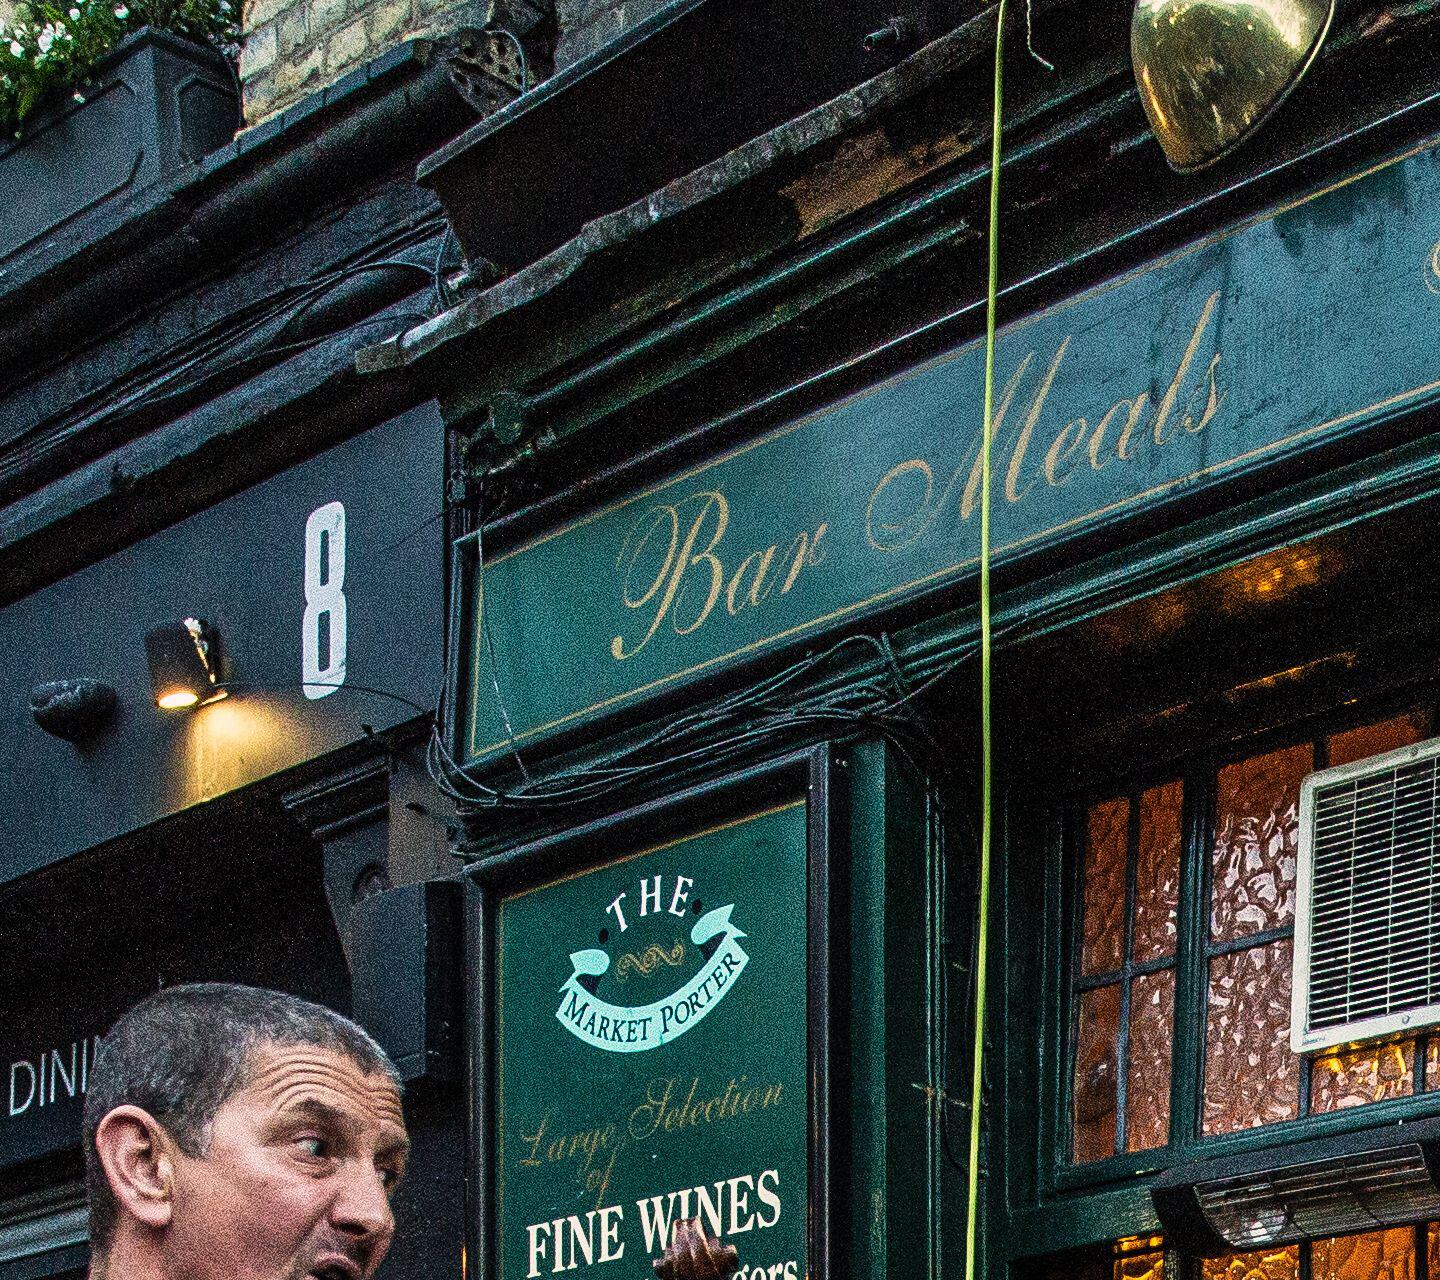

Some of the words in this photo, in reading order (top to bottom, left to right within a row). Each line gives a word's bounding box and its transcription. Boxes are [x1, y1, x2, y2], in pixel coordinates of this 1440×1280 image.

[612, 487, 828, 661] Bar
[866, 289, 1231, 554] Meals
[300, 499, 349, 702] 8
[605, 874, 695, 933] THE
[563, 988, 653, 1043] MARKET
[660, 952, 741, 1035] PORTER
[519, 1107, 617, 1176] Large
[627, 1074, 784, 1141] Selection
[526, 1204, 625, 1280] FINE
[635, 1168, 782, 1255] WINES
